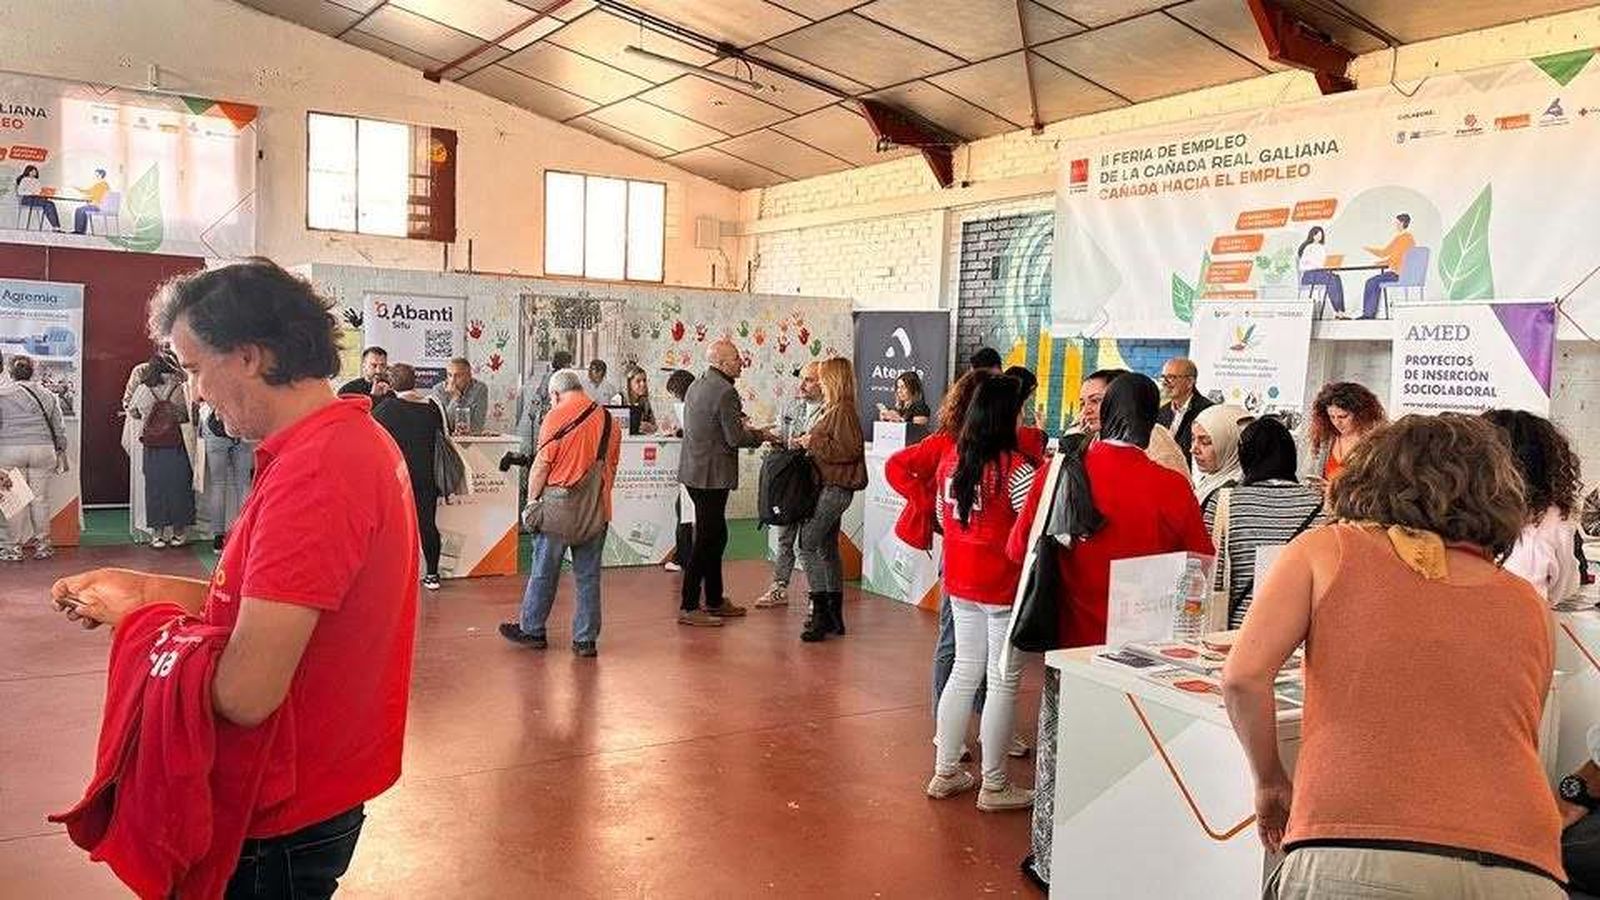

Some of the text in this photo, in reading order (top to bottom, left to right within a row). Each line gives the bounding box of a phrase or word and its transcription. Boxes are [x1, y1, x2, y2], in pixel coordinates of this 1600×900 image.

[1112, 148, 1153, 166] FERIA
[1158, 144, 1177, 159] DE
[1181, 133, 1247, 155] EMPLEO
[1099, 139, 1339, 184] DE LA CAÑADA REAL GALIANA
[1099, 183, 1158, 200] CAÑADA
[1162, 176, 1210, 193] HACIA
[1214, 174, 1235, 187] EL
[1240, 163, 1311, 184] EMPLEO
[391, 304, 453, 322] Abanti
[1405, 324, 1470, 341] AMED
[1405, 354, 1474, 367] PROYECTOS
[1404, 368, 1489, 382] DE INSERCIÓN
[1403, 383, 1498, 398] SOCIOLABORAL
